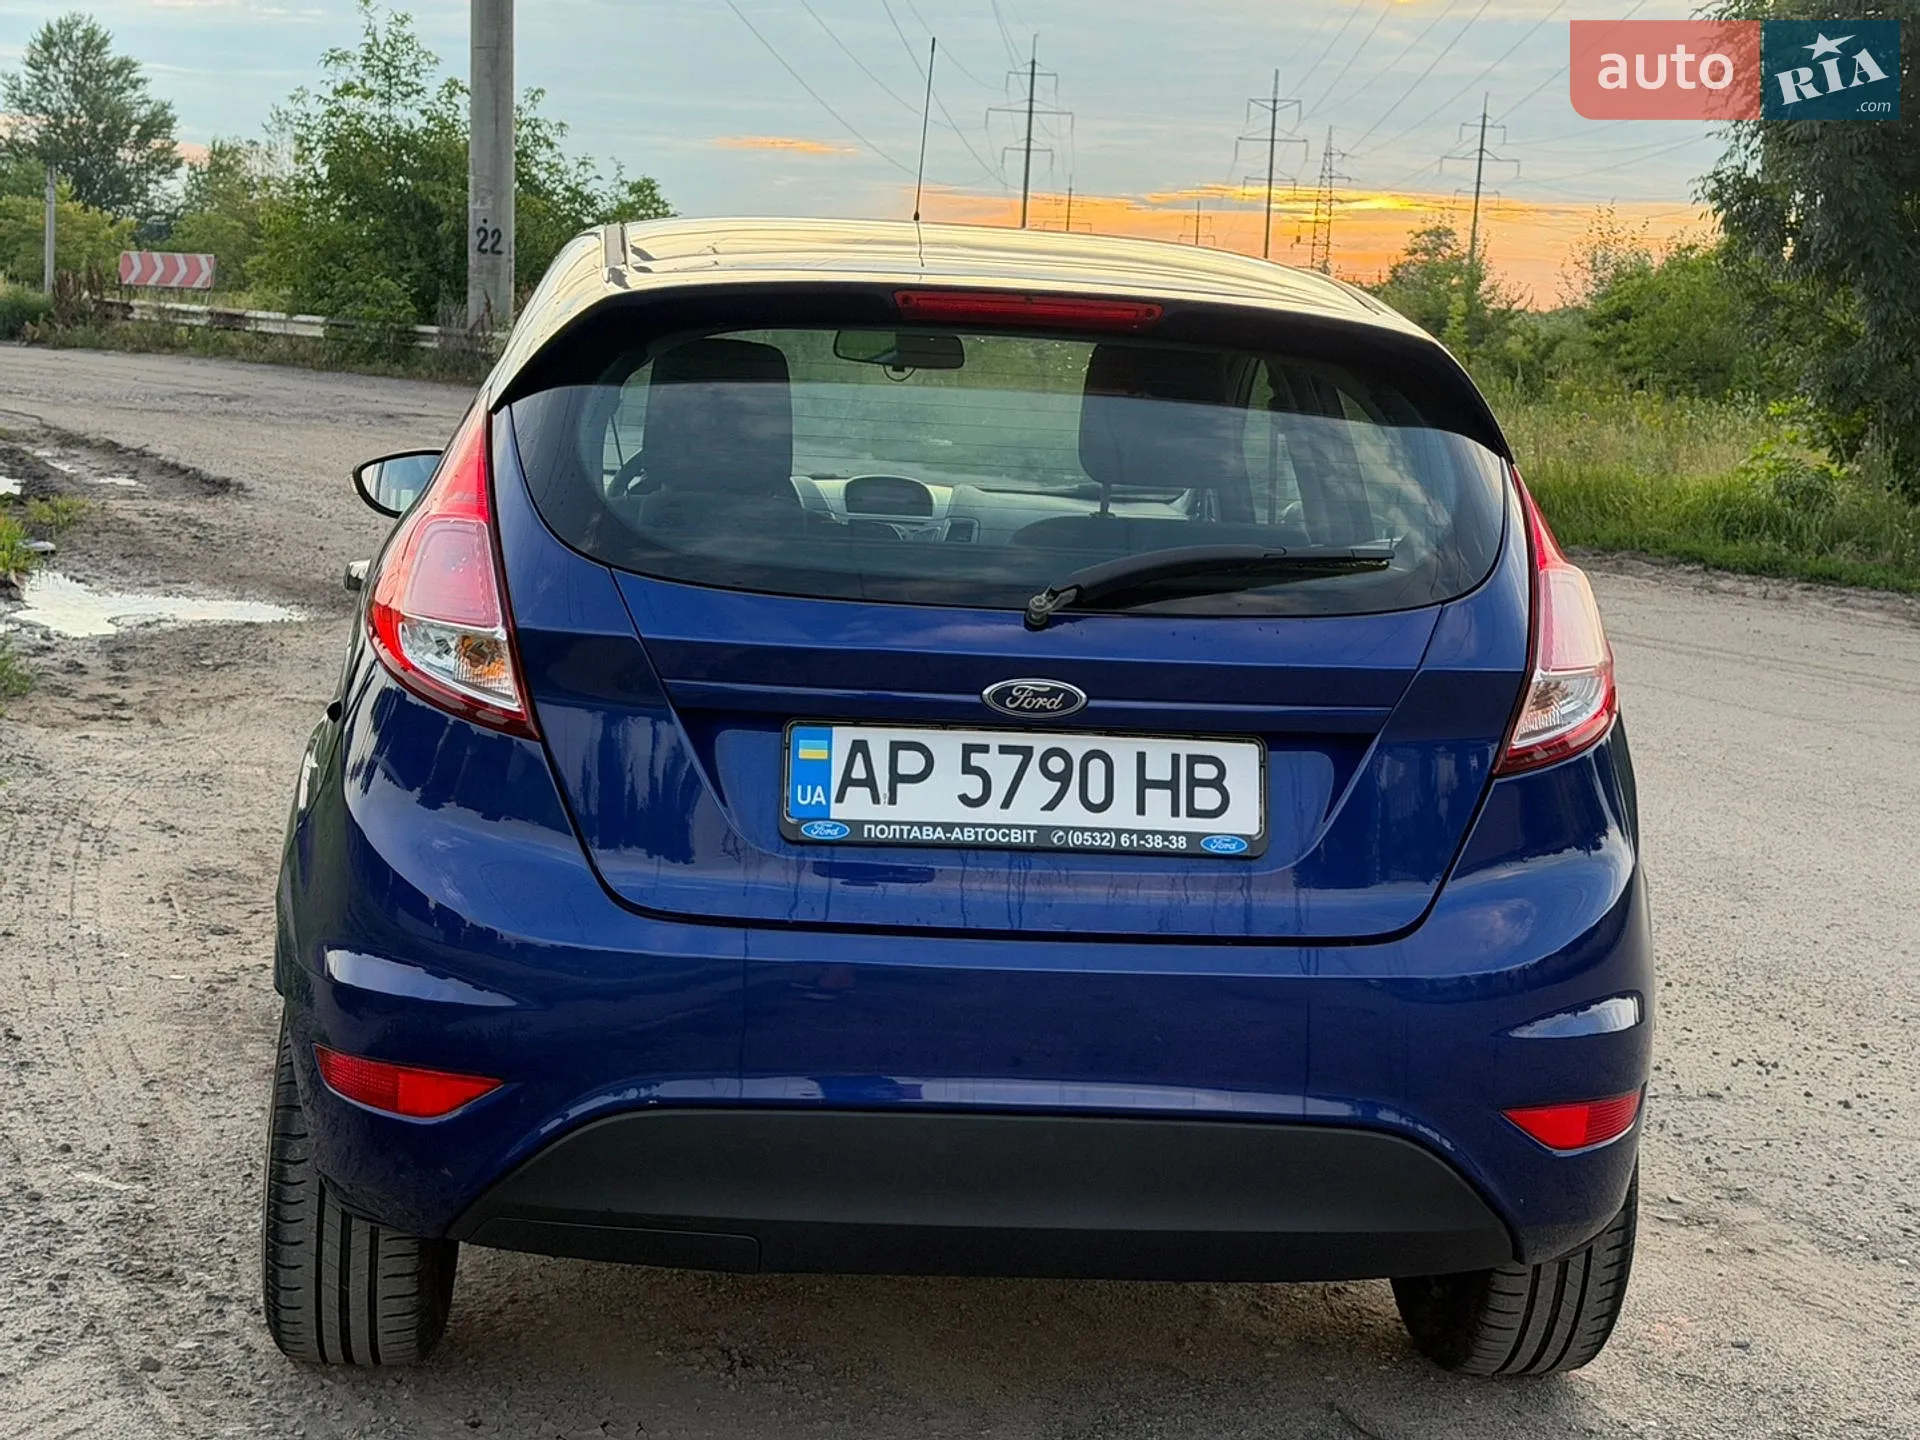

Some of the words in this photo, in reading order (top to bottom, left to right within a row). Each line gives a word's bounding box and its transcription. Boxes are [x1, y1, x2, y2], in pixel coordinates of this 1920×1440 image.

[476, 226, 504, 256] 22
[1005, 685, 1065, 711] Ford
[834, 738, 935, 807] AP
[957, 743, 1116, 813] 5790
[1136, 750, 1231, 819] HB
[797, 785, 827, 806] UA
[809, 823, 840, 838] Ford
[863, 823, 1037, 844] ПОЛТАВА-АВТОСВІТ
[1067, 830, 1116, 848] (0532)
[1120, 832, 1187, 850] 61-38-38
[1209, 837, 1239, 852] Ford
